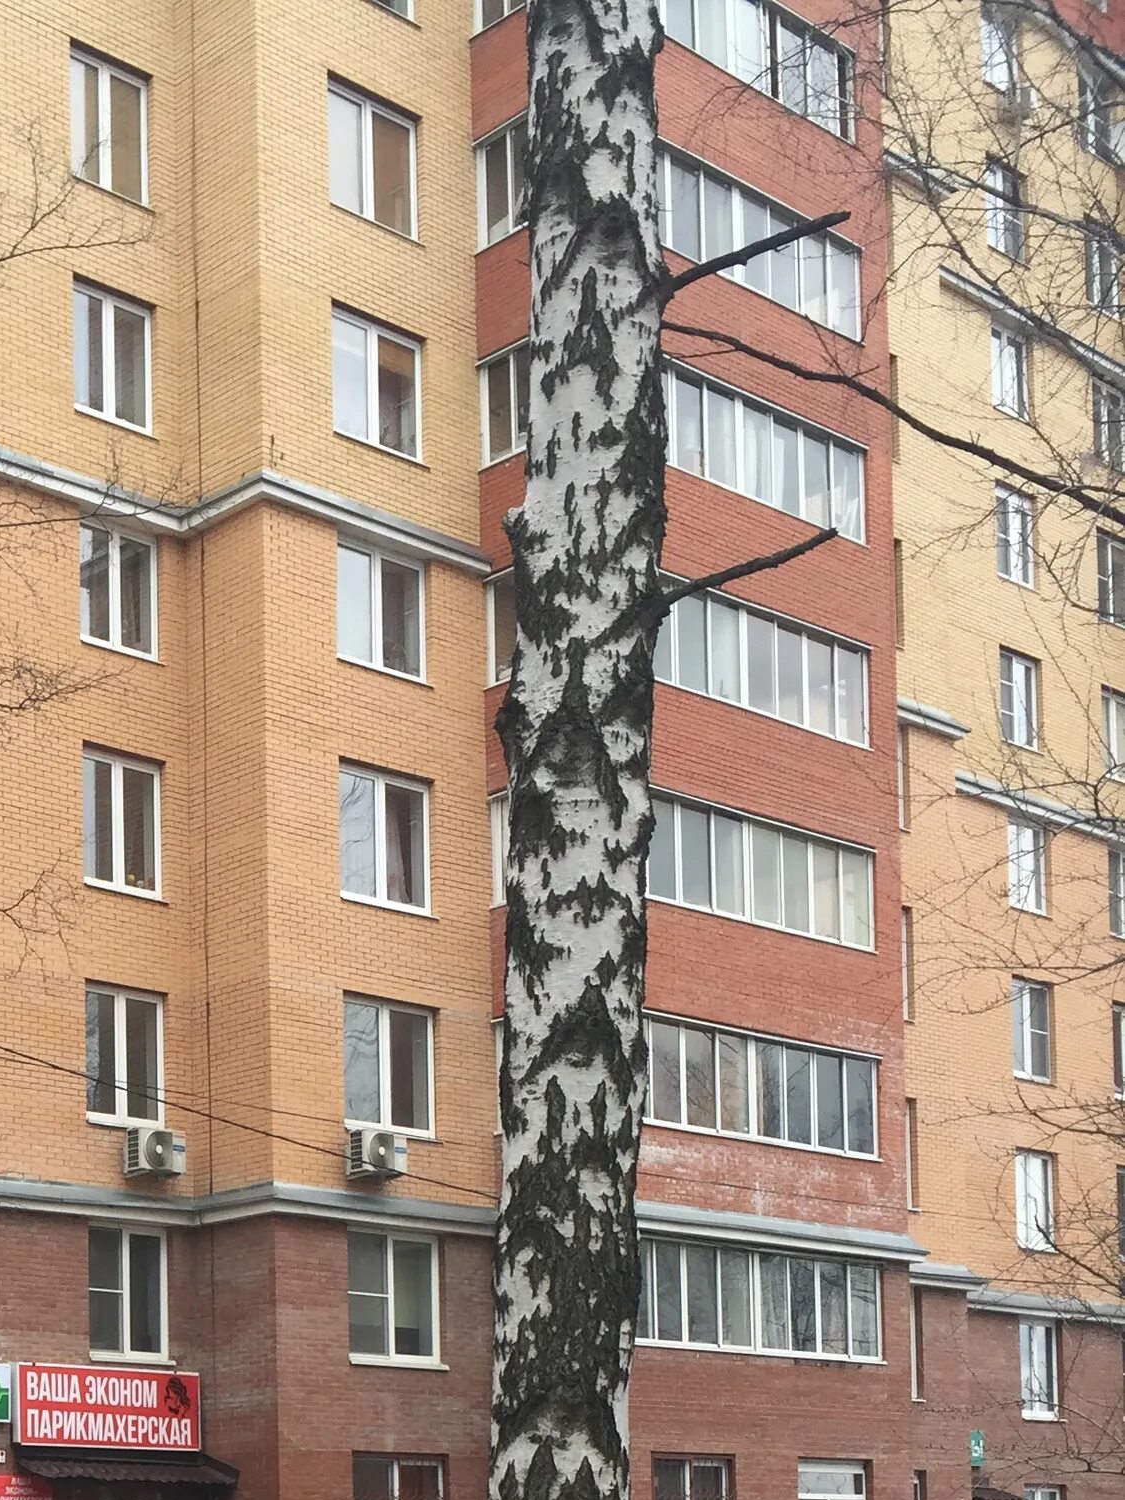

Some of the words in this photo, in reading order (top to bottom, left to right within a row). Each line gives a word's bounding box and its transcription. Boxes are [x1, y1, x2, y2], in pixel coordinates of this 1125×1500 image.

[26, 1371, 82, 1404] ВАША
[85, 1375, 158, 1409] ЭКОНОМ
[26, 1407, 193, 1447] ПАРИКМАХЕРСКАЯ
